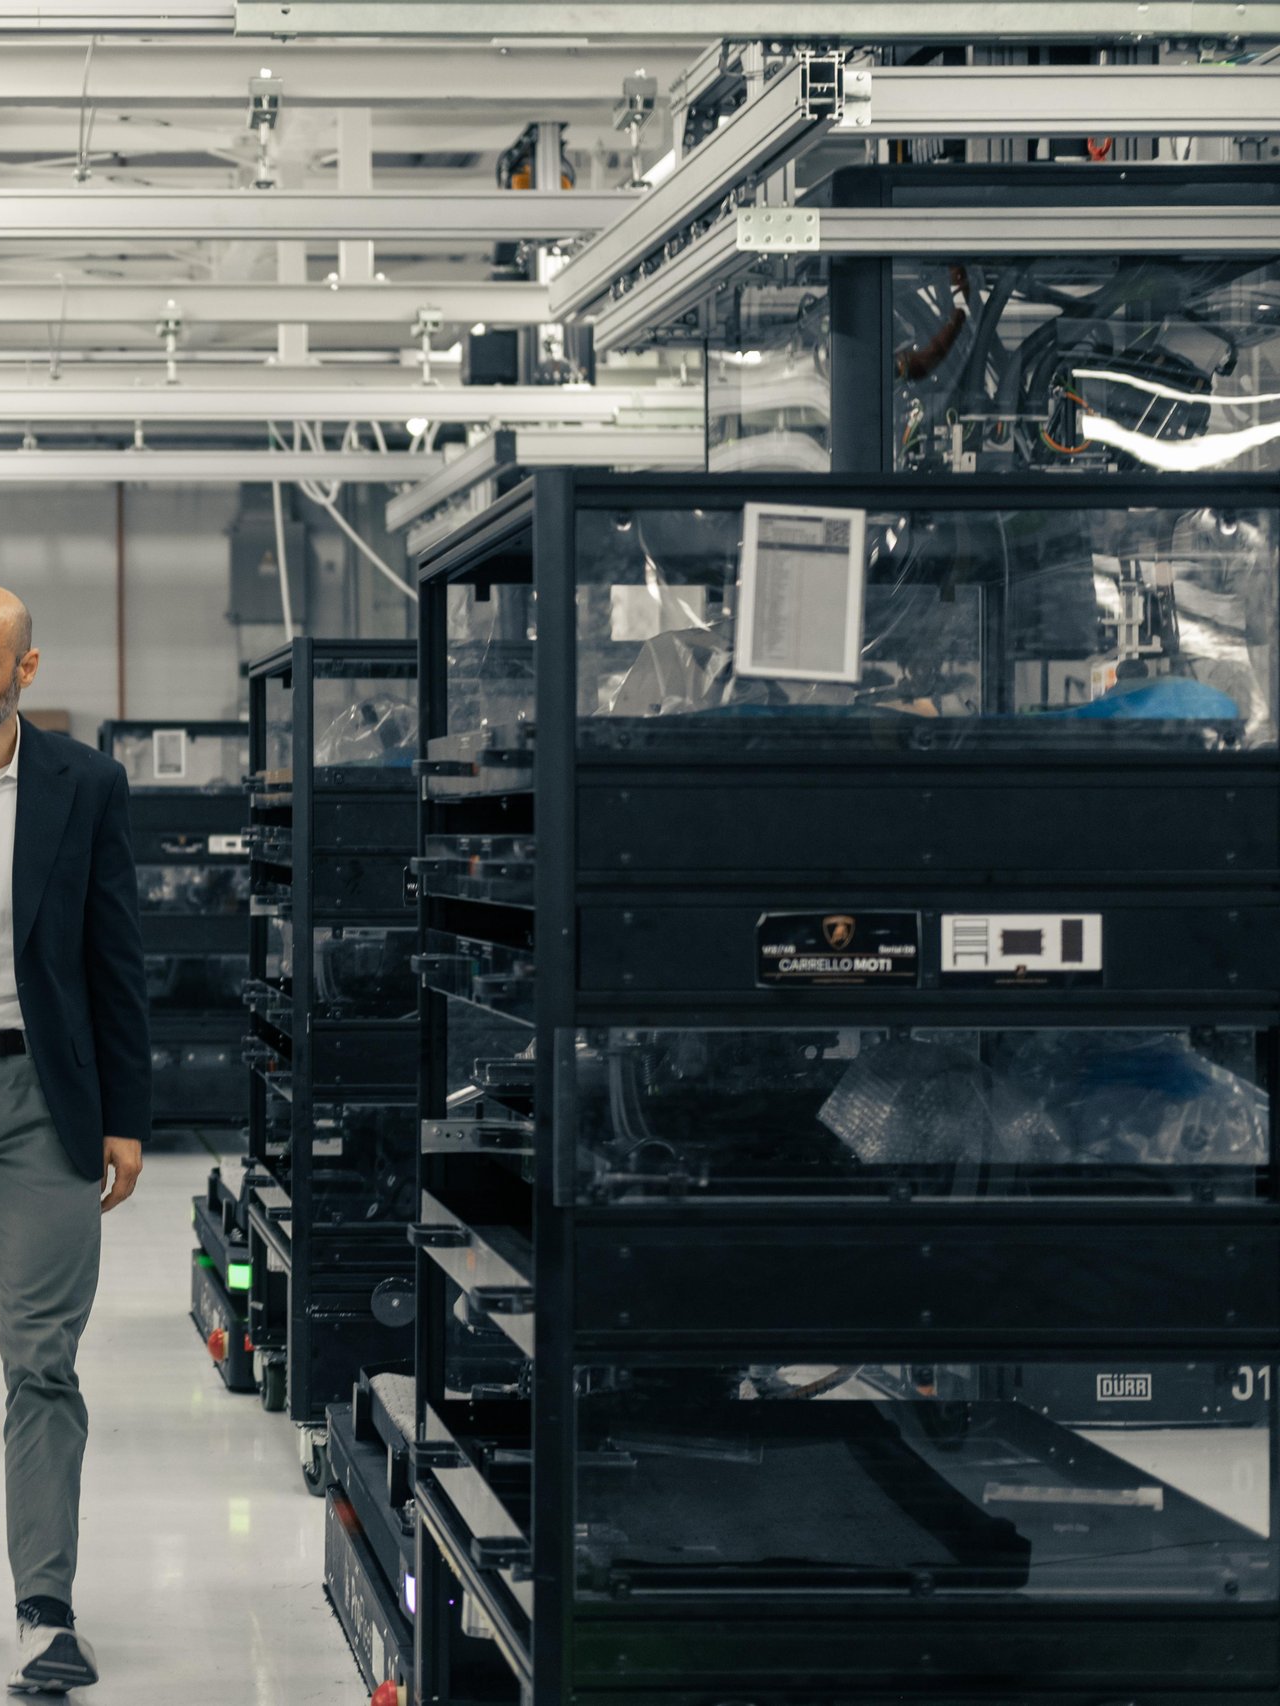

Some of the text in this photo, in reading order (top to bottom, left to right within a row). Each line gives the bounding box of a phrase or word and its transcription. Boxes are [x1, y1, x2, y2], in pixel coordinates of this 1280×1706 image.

[778, 958, 892, 971] CARRELLO MOTI
[1102, 1375, 1146, 1396] DÜRR
